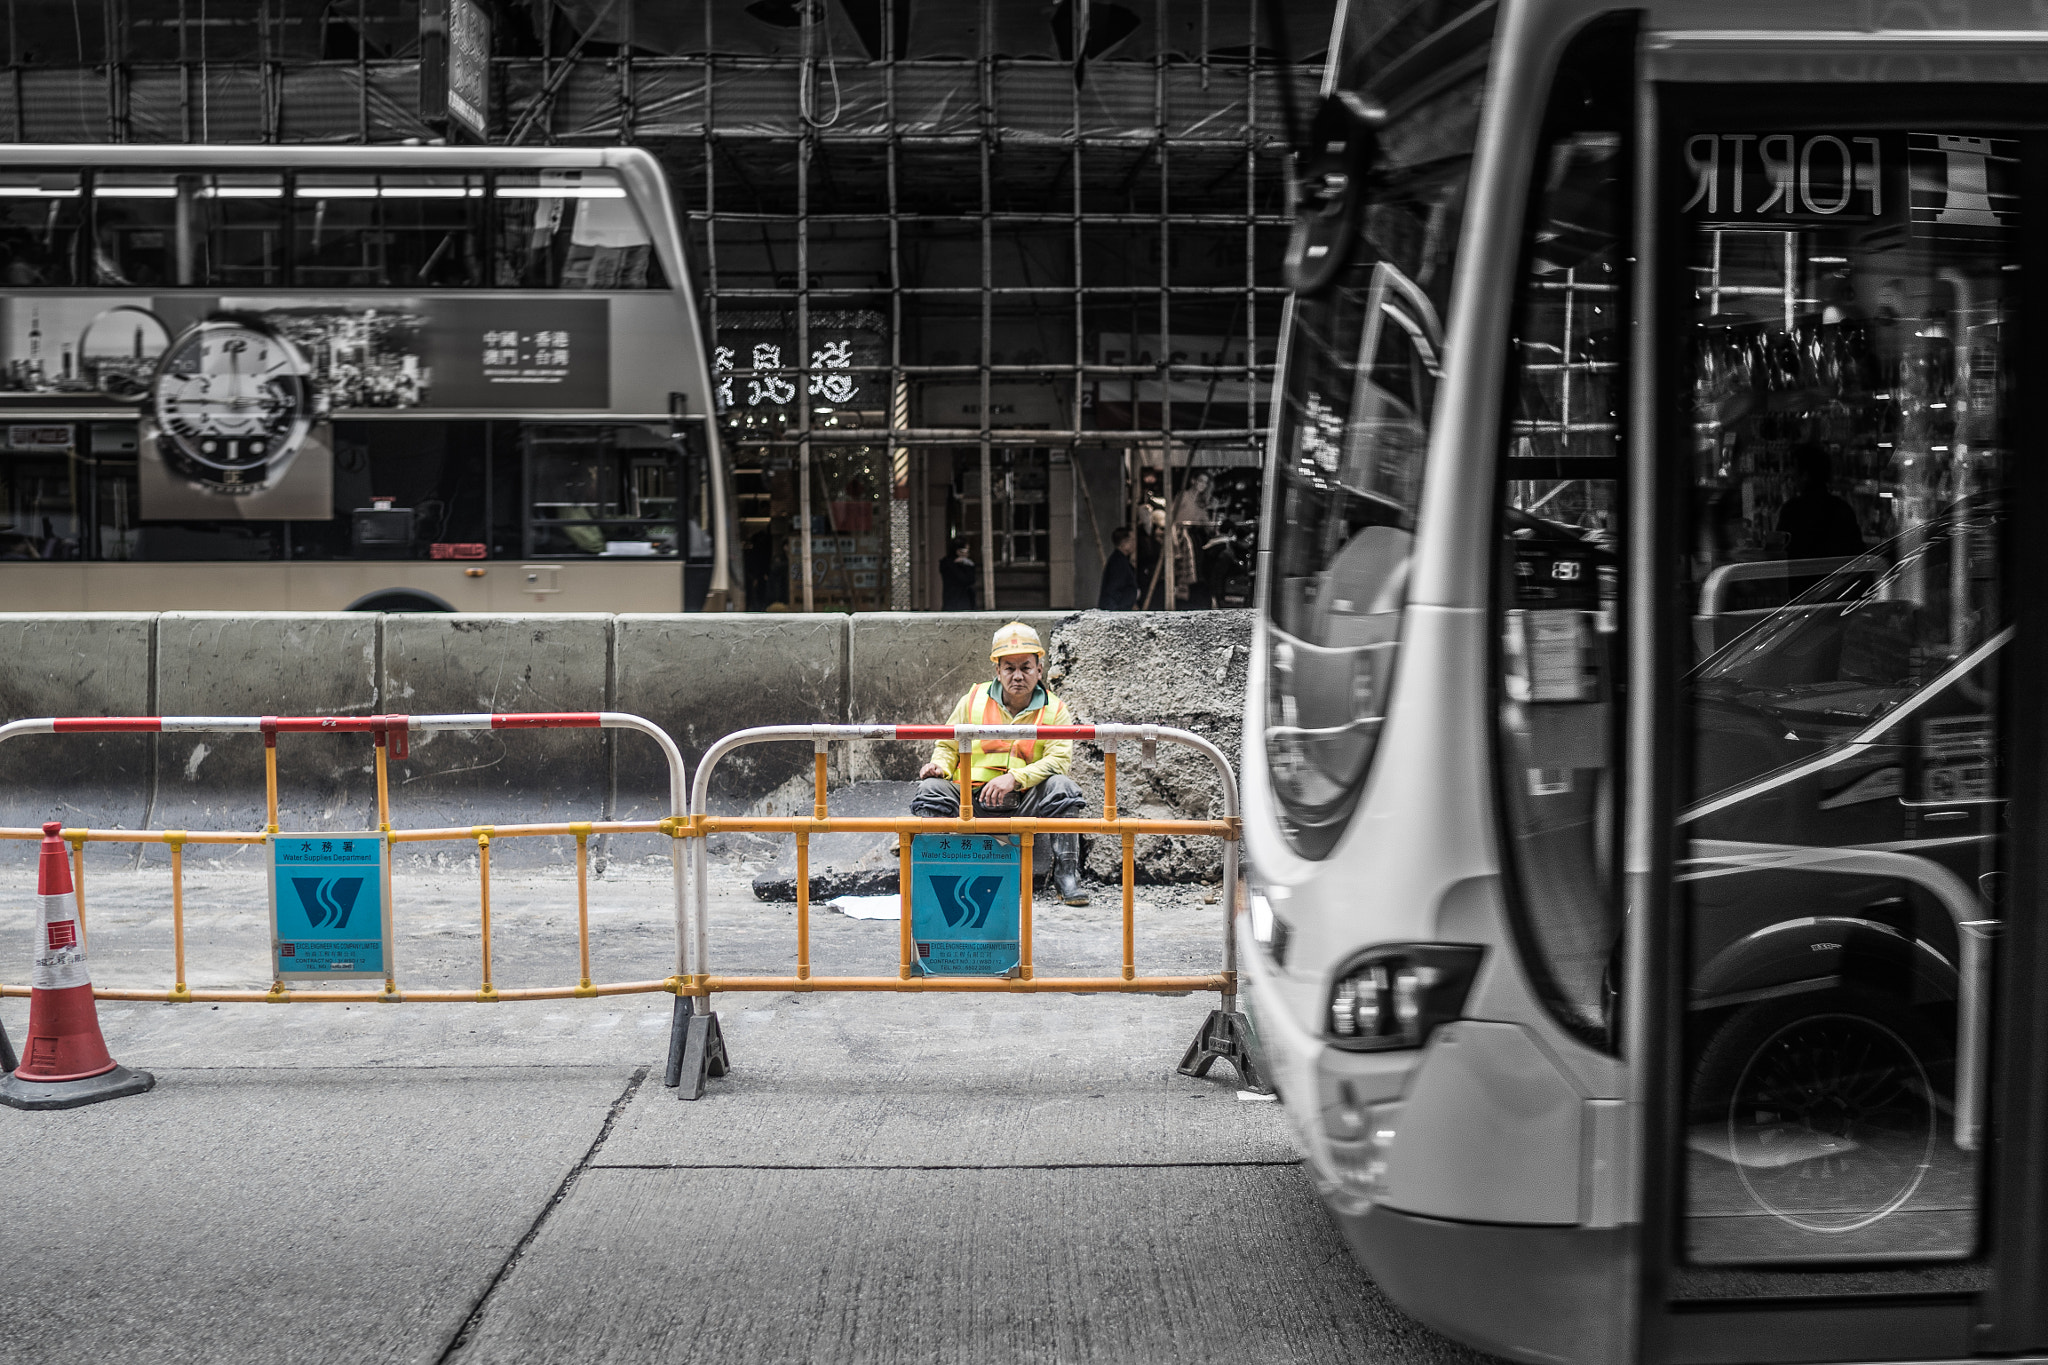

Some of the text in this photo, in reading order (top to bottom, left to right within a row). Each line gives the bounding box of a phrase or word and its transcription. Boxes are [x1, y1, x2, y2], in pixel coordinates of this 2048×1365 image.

[301, 841, 353, 853] 水務署
[939, 838, 993, 851] 水務署
[283, 853, 371, 862] Water Supplies Department
[921, 851, 1012, 861] Water Supplies Department
